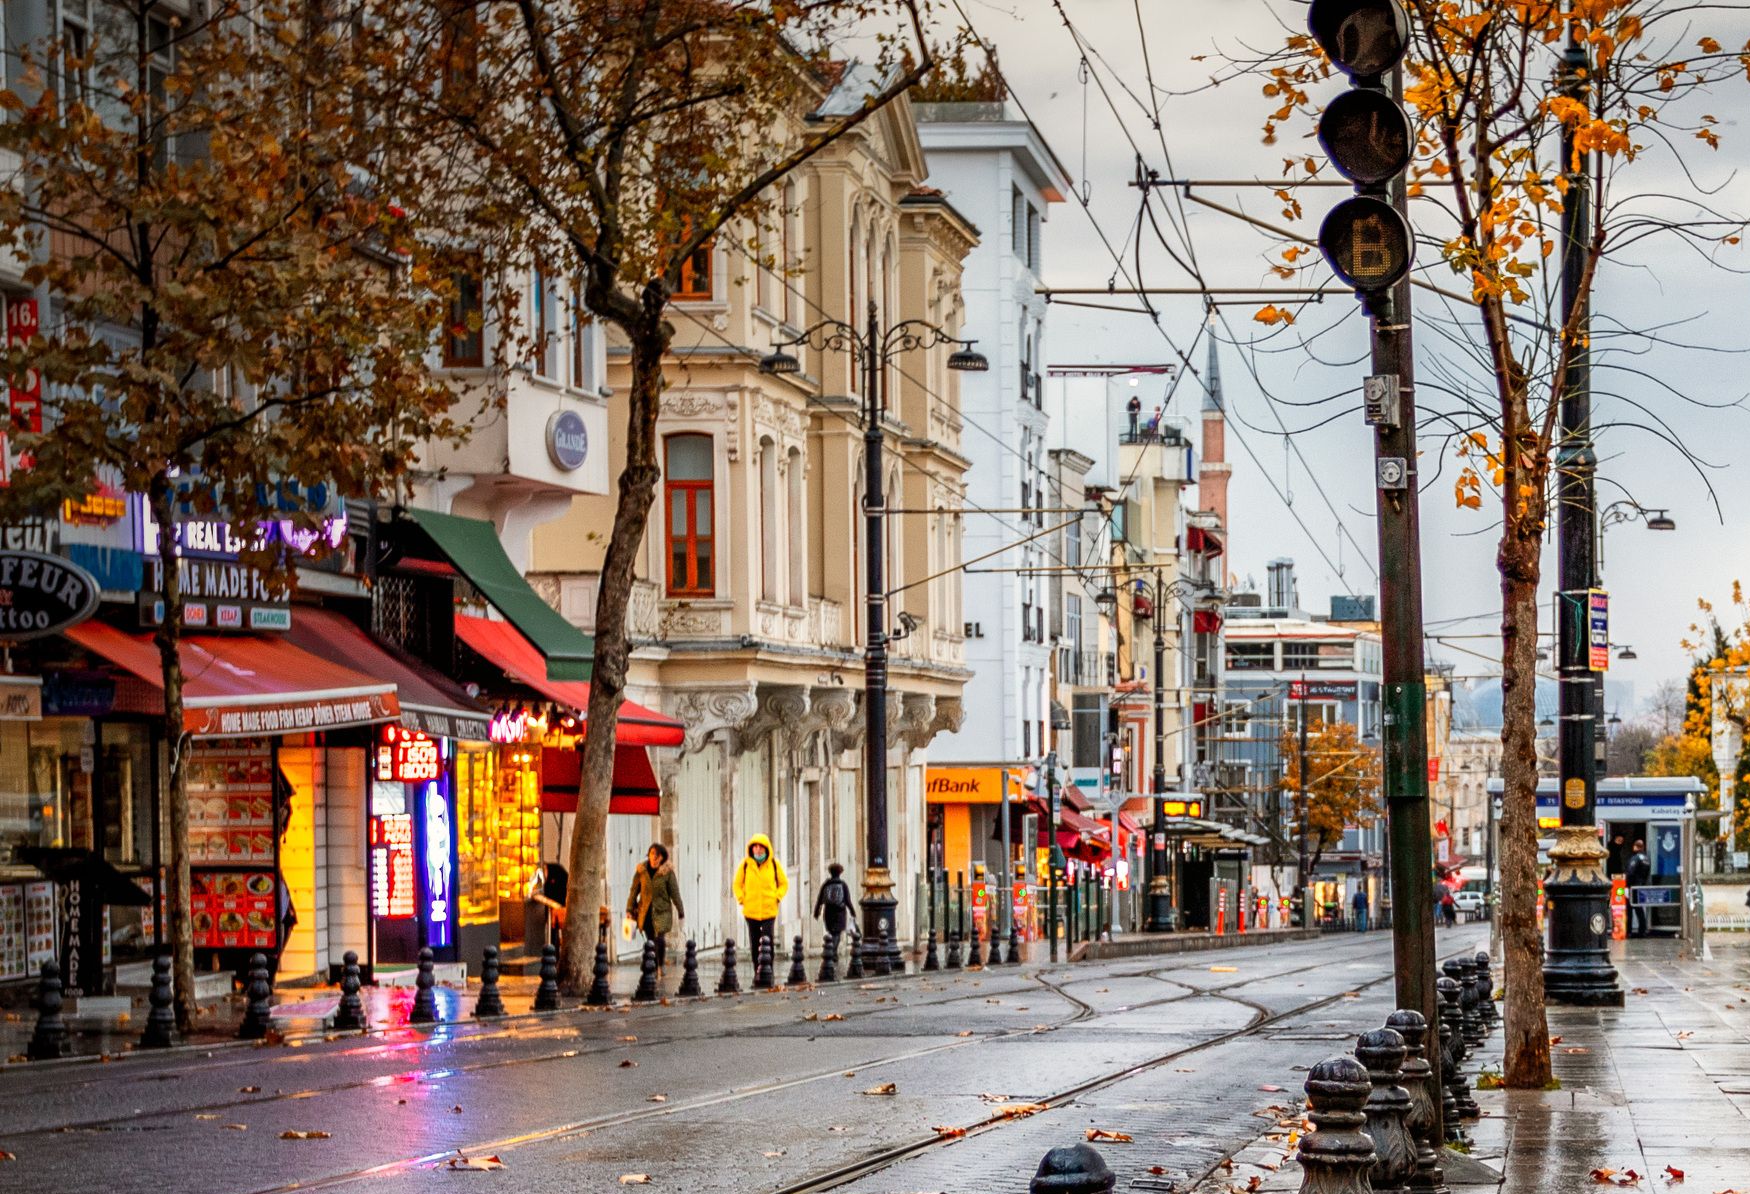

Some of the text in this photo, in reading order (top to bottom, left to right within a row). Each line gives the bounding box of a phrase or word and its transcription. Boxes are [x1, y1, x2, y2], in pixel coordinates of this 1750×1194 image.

[9, 302, 37, 328] 16.
[556, 428, 586, 453] GRANDE
[187, 521, 221, 552] REAL
[154, 555, 200, 596] HME
[205, 562, 249, 599] MADE
[964, 622, 985, 638] EL
[260, 708, 279, 731] FOOD
[278, 707, 295, 729] FISH
[294, 705, 314, 728] KEBAP
[1651, 807, 1681, 815] Kabataş
